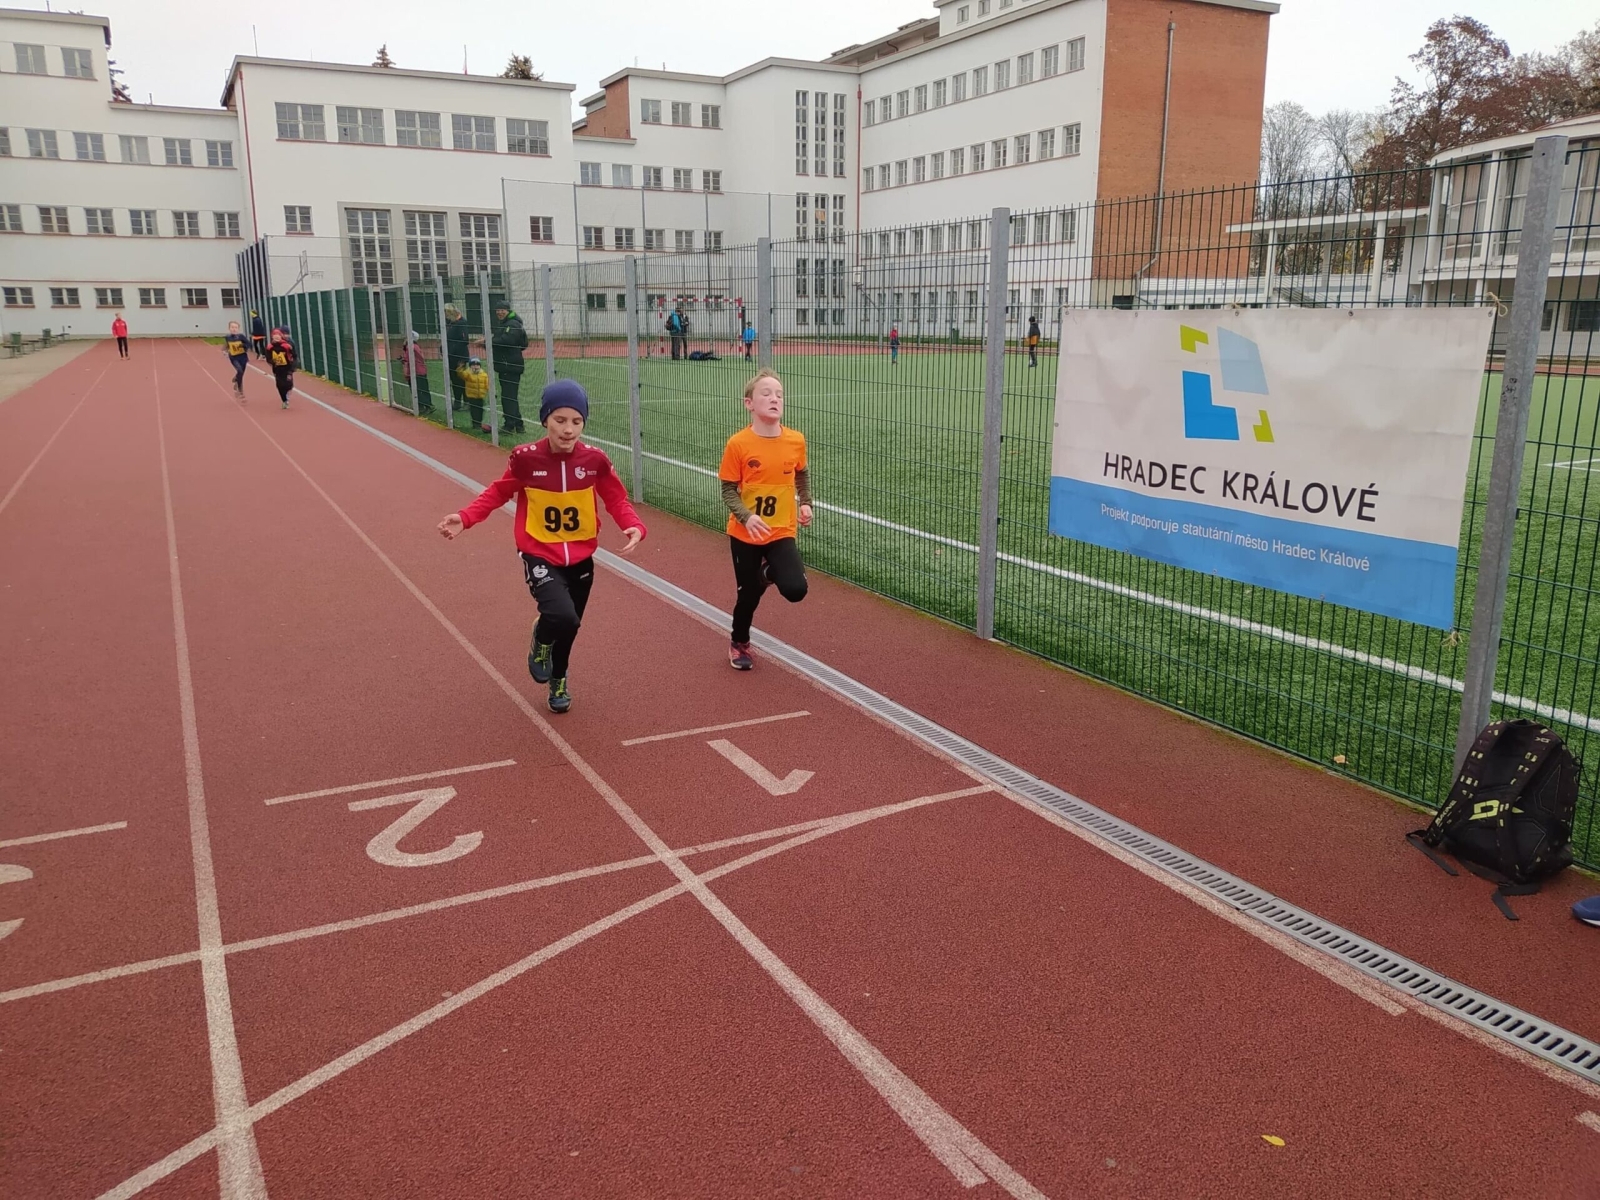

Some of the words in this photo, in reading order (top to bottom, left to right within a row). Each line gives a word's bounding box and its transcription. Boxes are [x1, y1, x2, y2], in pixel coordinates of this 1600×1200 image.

[754, 495, 777, 517] 18
[1103, 452, 1207, 494] HRADEC
[1222, 470, 1379, 522] KRÁLOVÉ
[544, 506, 580, 533] 93
[1101, 503, 1129, 521] Projekt
[1131, 513, 1179, 534] podporuje
[1182, 522, 1234, 543] statutární
[1235, 533, 1269, 552] město
[1272, 538, 1316, 561] Hradec
[1320, 548, 1370, 571] Králové
[706, 738, 816, 797] 1
[348, 785, 485, 868] 2
